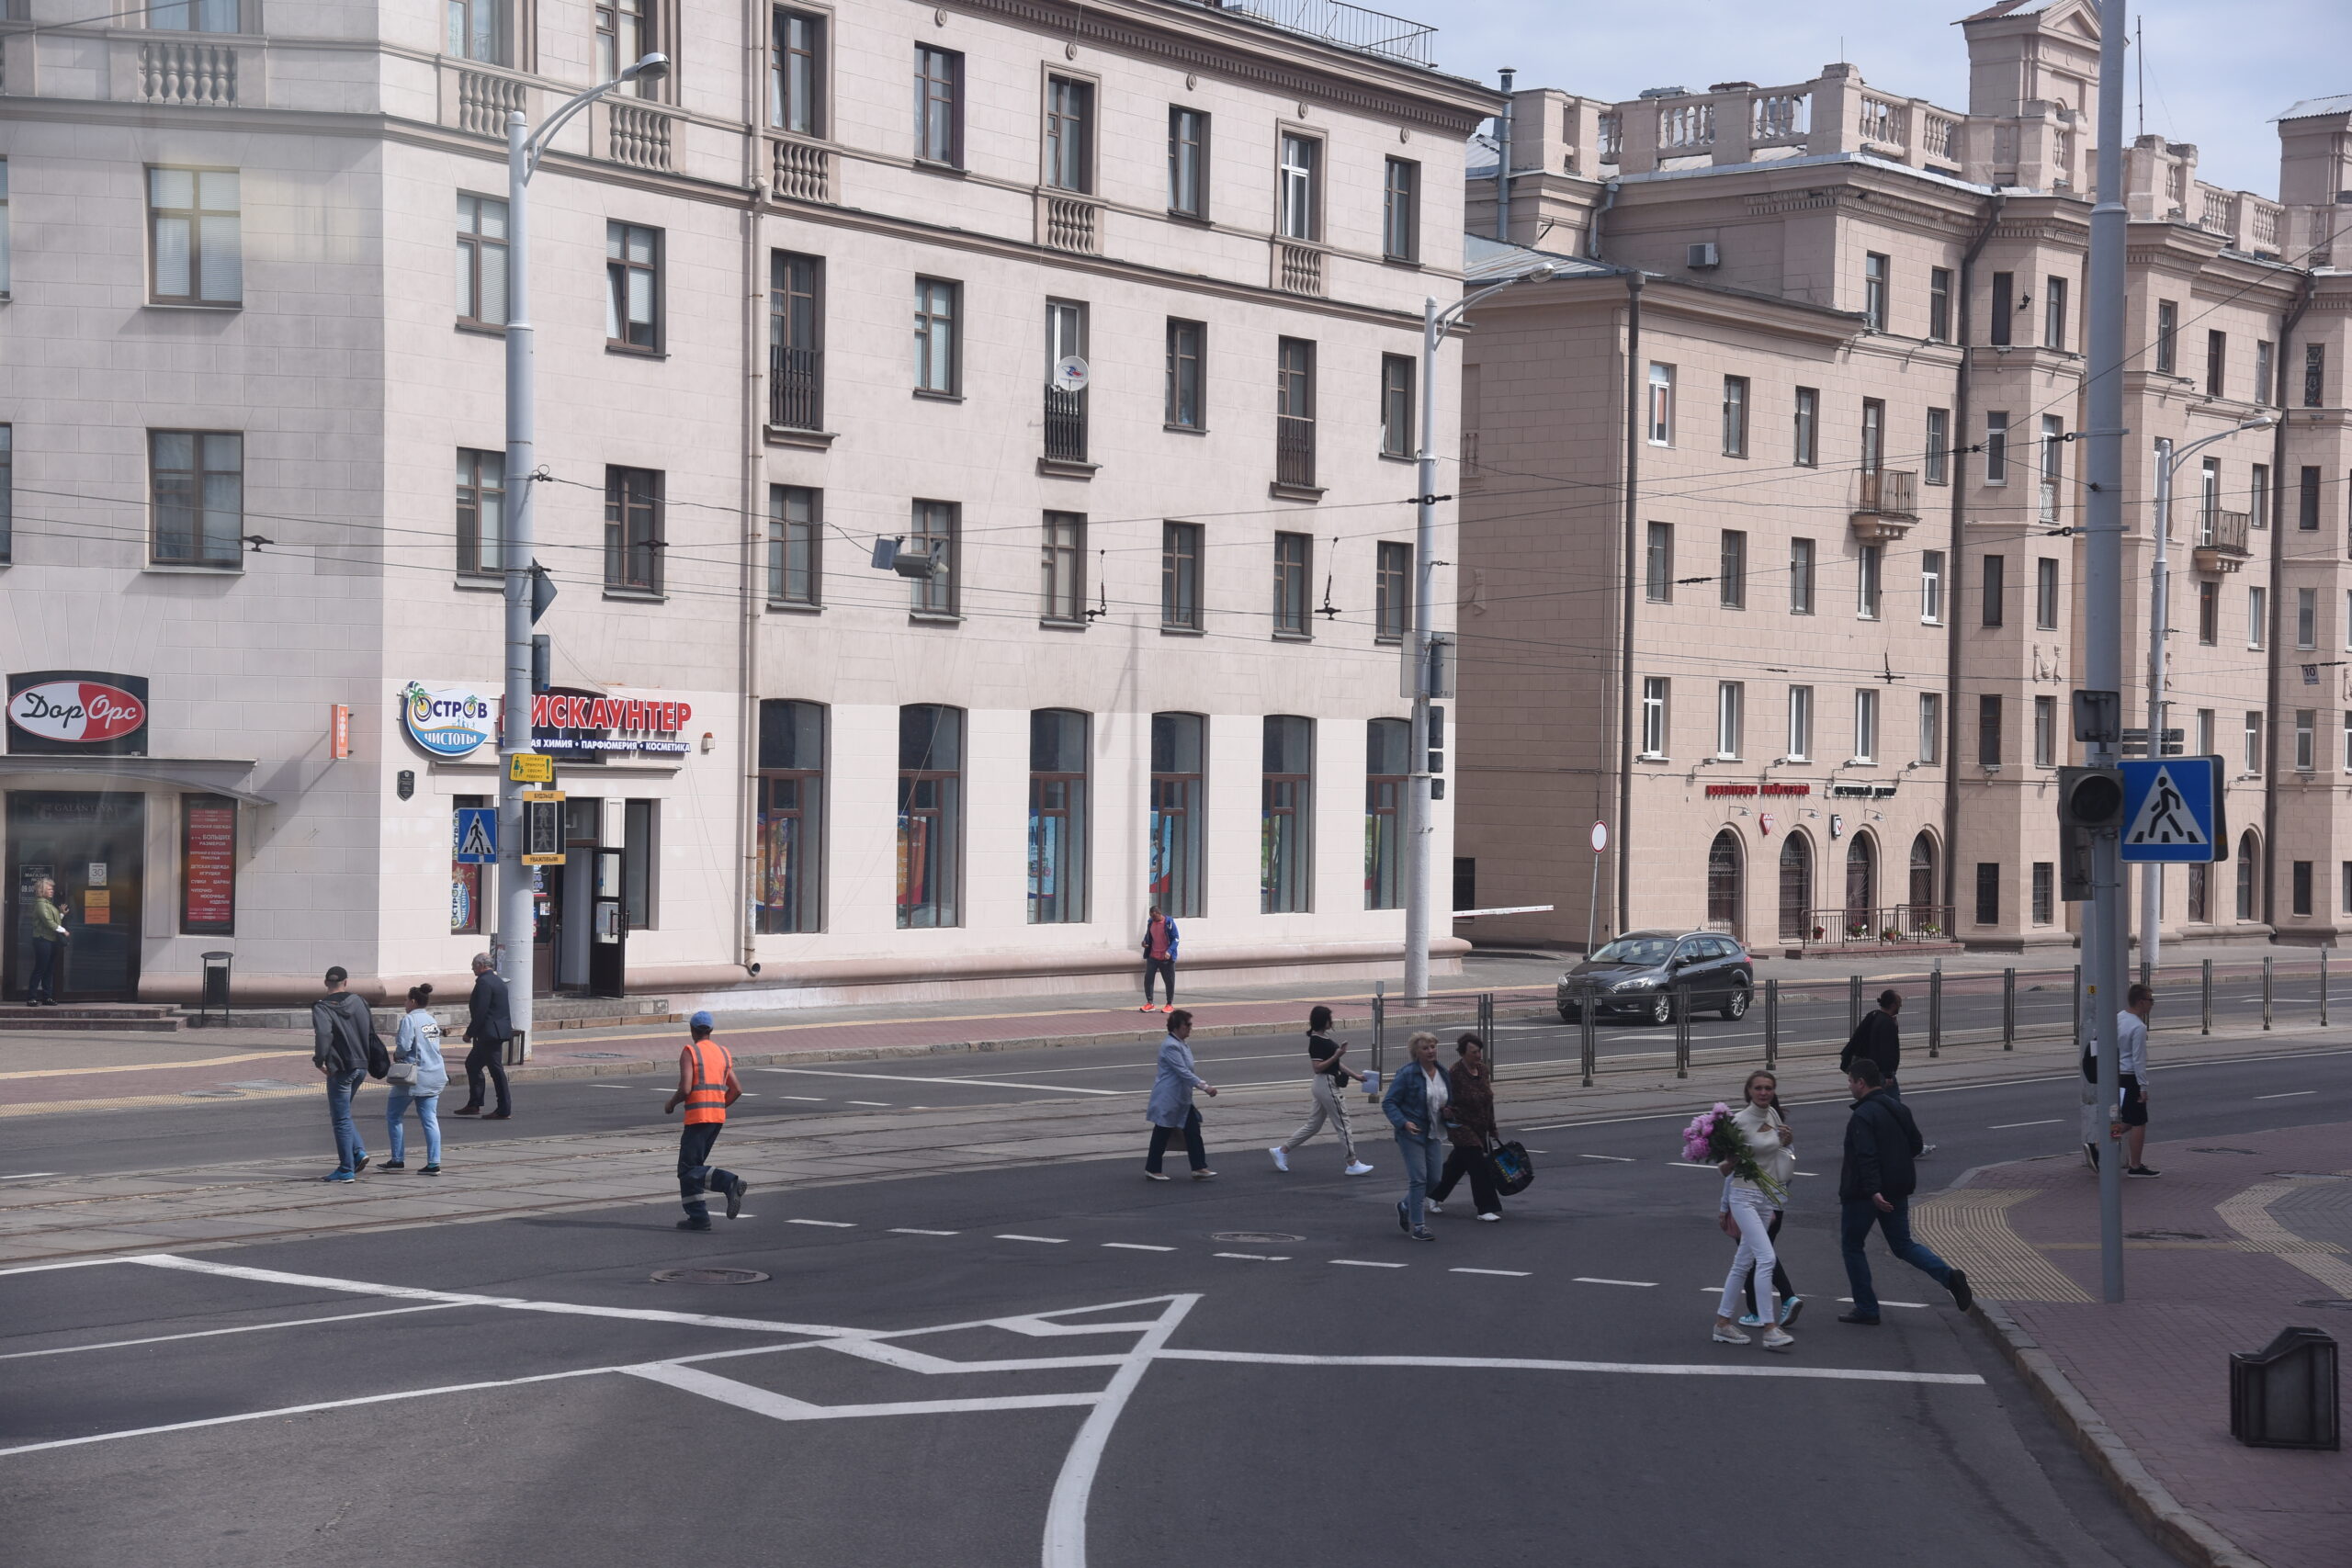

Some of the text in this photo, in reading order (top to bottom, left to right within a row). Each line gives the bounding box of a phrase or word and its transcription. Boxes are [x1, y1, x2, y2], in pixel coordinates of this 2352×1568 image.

[2305, 667, 2316, 676] 10
[413, 695, 488, 723] ОСТРОВ
[499, 694, 692, 732] ИСКАУНТЕР
[424, 732, 478, 745] ЧИСТОТЫ
[543, 739, 572, 749] ХИМИЯ
[581, 740, 638, 750] ПАРФЮМЕРИЯ
[645, 742, 691, 752] КОСМЕТИКА
